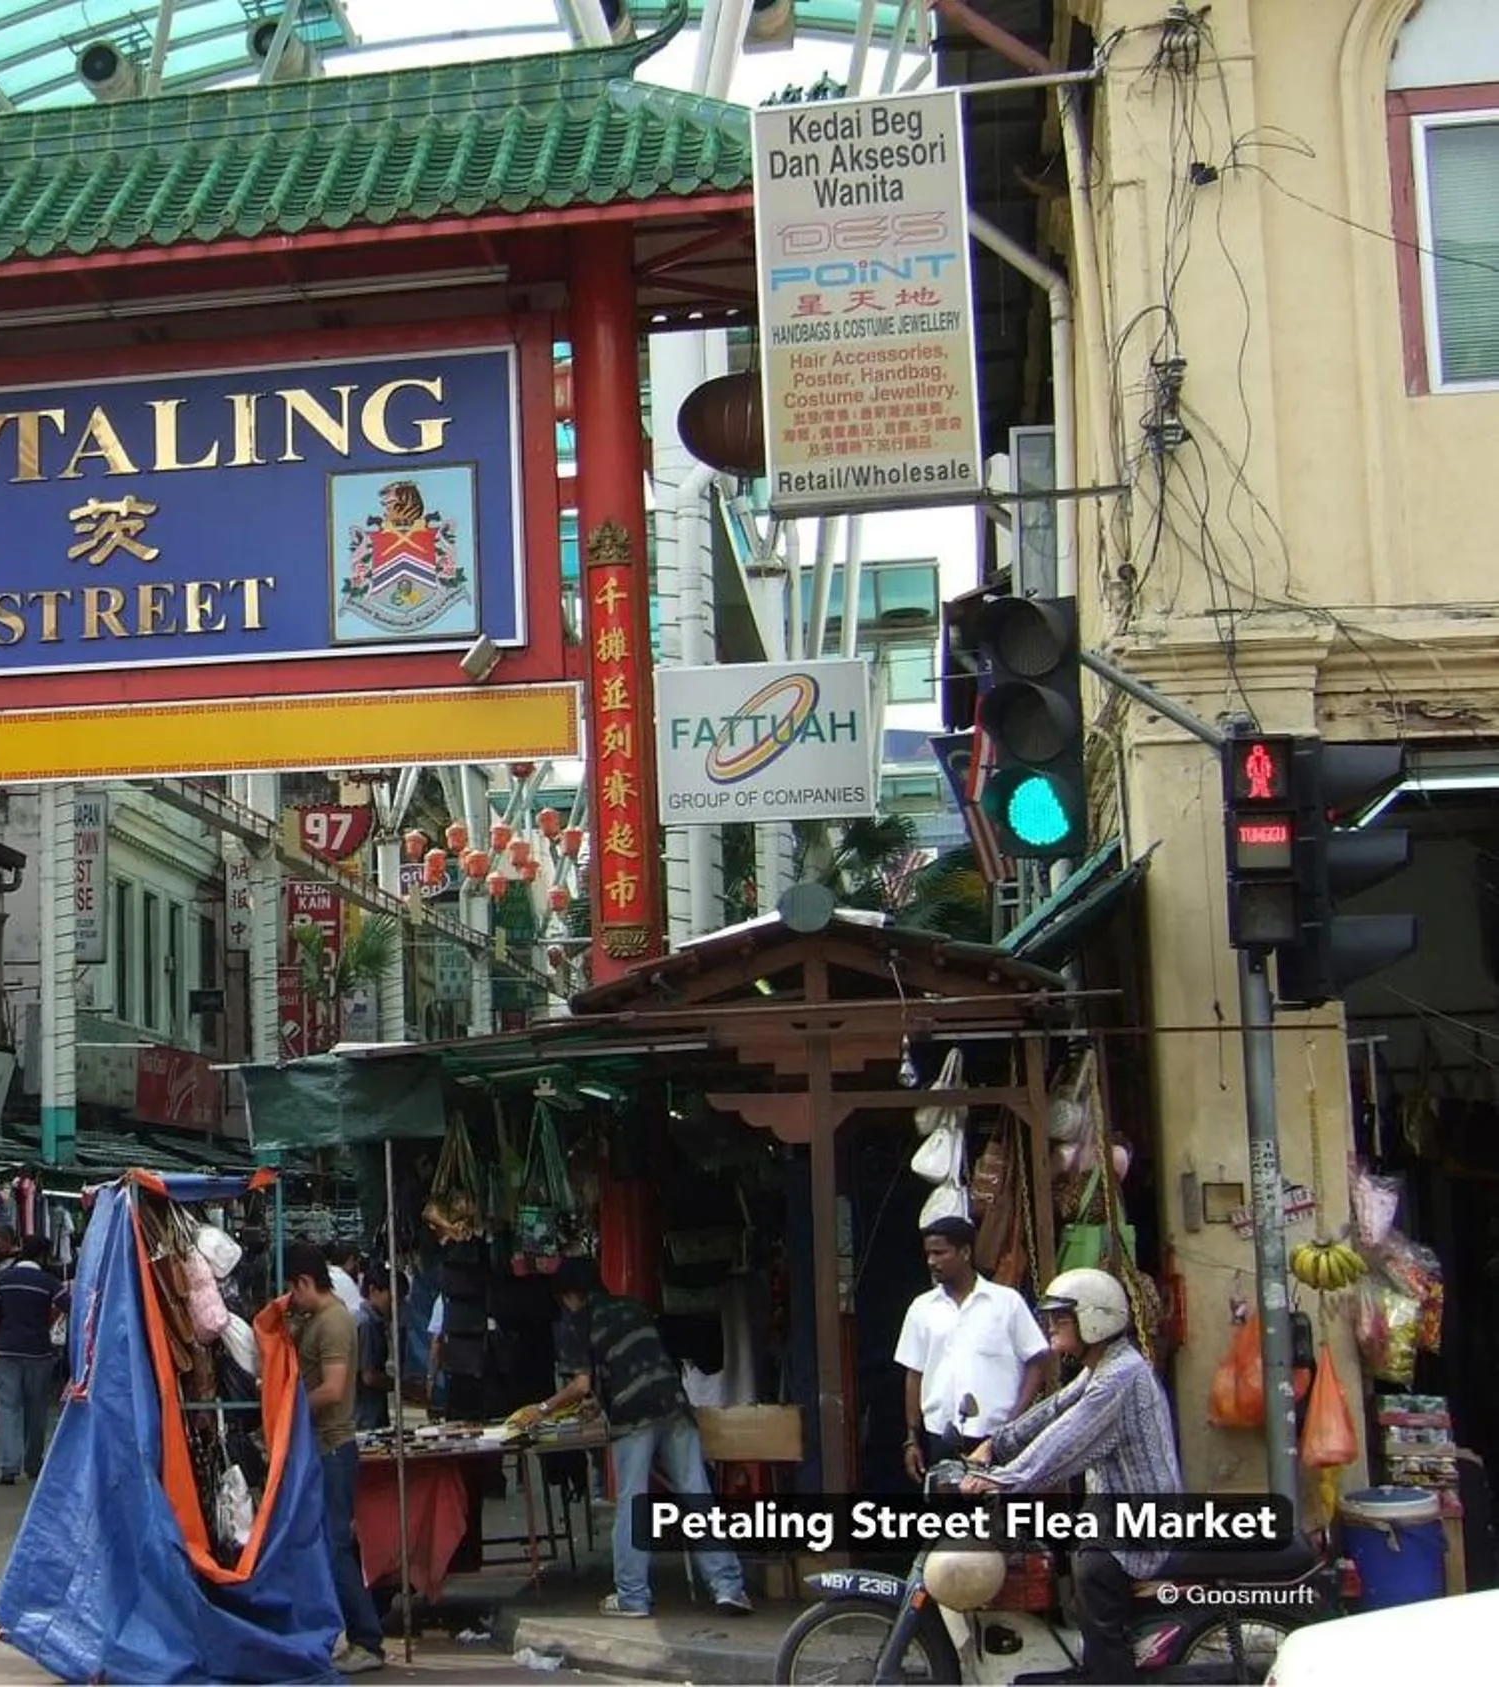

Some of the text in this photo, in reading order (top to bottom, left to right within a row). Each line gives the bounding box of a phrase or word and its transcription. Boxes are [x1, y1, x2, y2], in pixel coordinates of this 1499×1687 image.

[788, 106, 923, 145] Kedai Beg
[769, 134, 947, 180] Dan Aksesori
[813, 174, 904, 208] Wanita
[791, 286, 941, 319] 星天地
[772, 311, 961, 346] HANDBAGS & COSTUME JEWELLERY
[790, 352, 826, 370] Hair
[783, 389, 865, 409] Costume
[778, 458, 971, 494] Retail/Wholesale
[671, 709, 857, 749] FATTUAH
[668, 786, 866, 810] GROUP OF COMPANIES
[305, 812, 353, 850] 97
[1238, 826, 1287, 843] TUNGGU
[297, 895, 331, 910] KAIN
[820, 1572, 854, 1591] WBY
